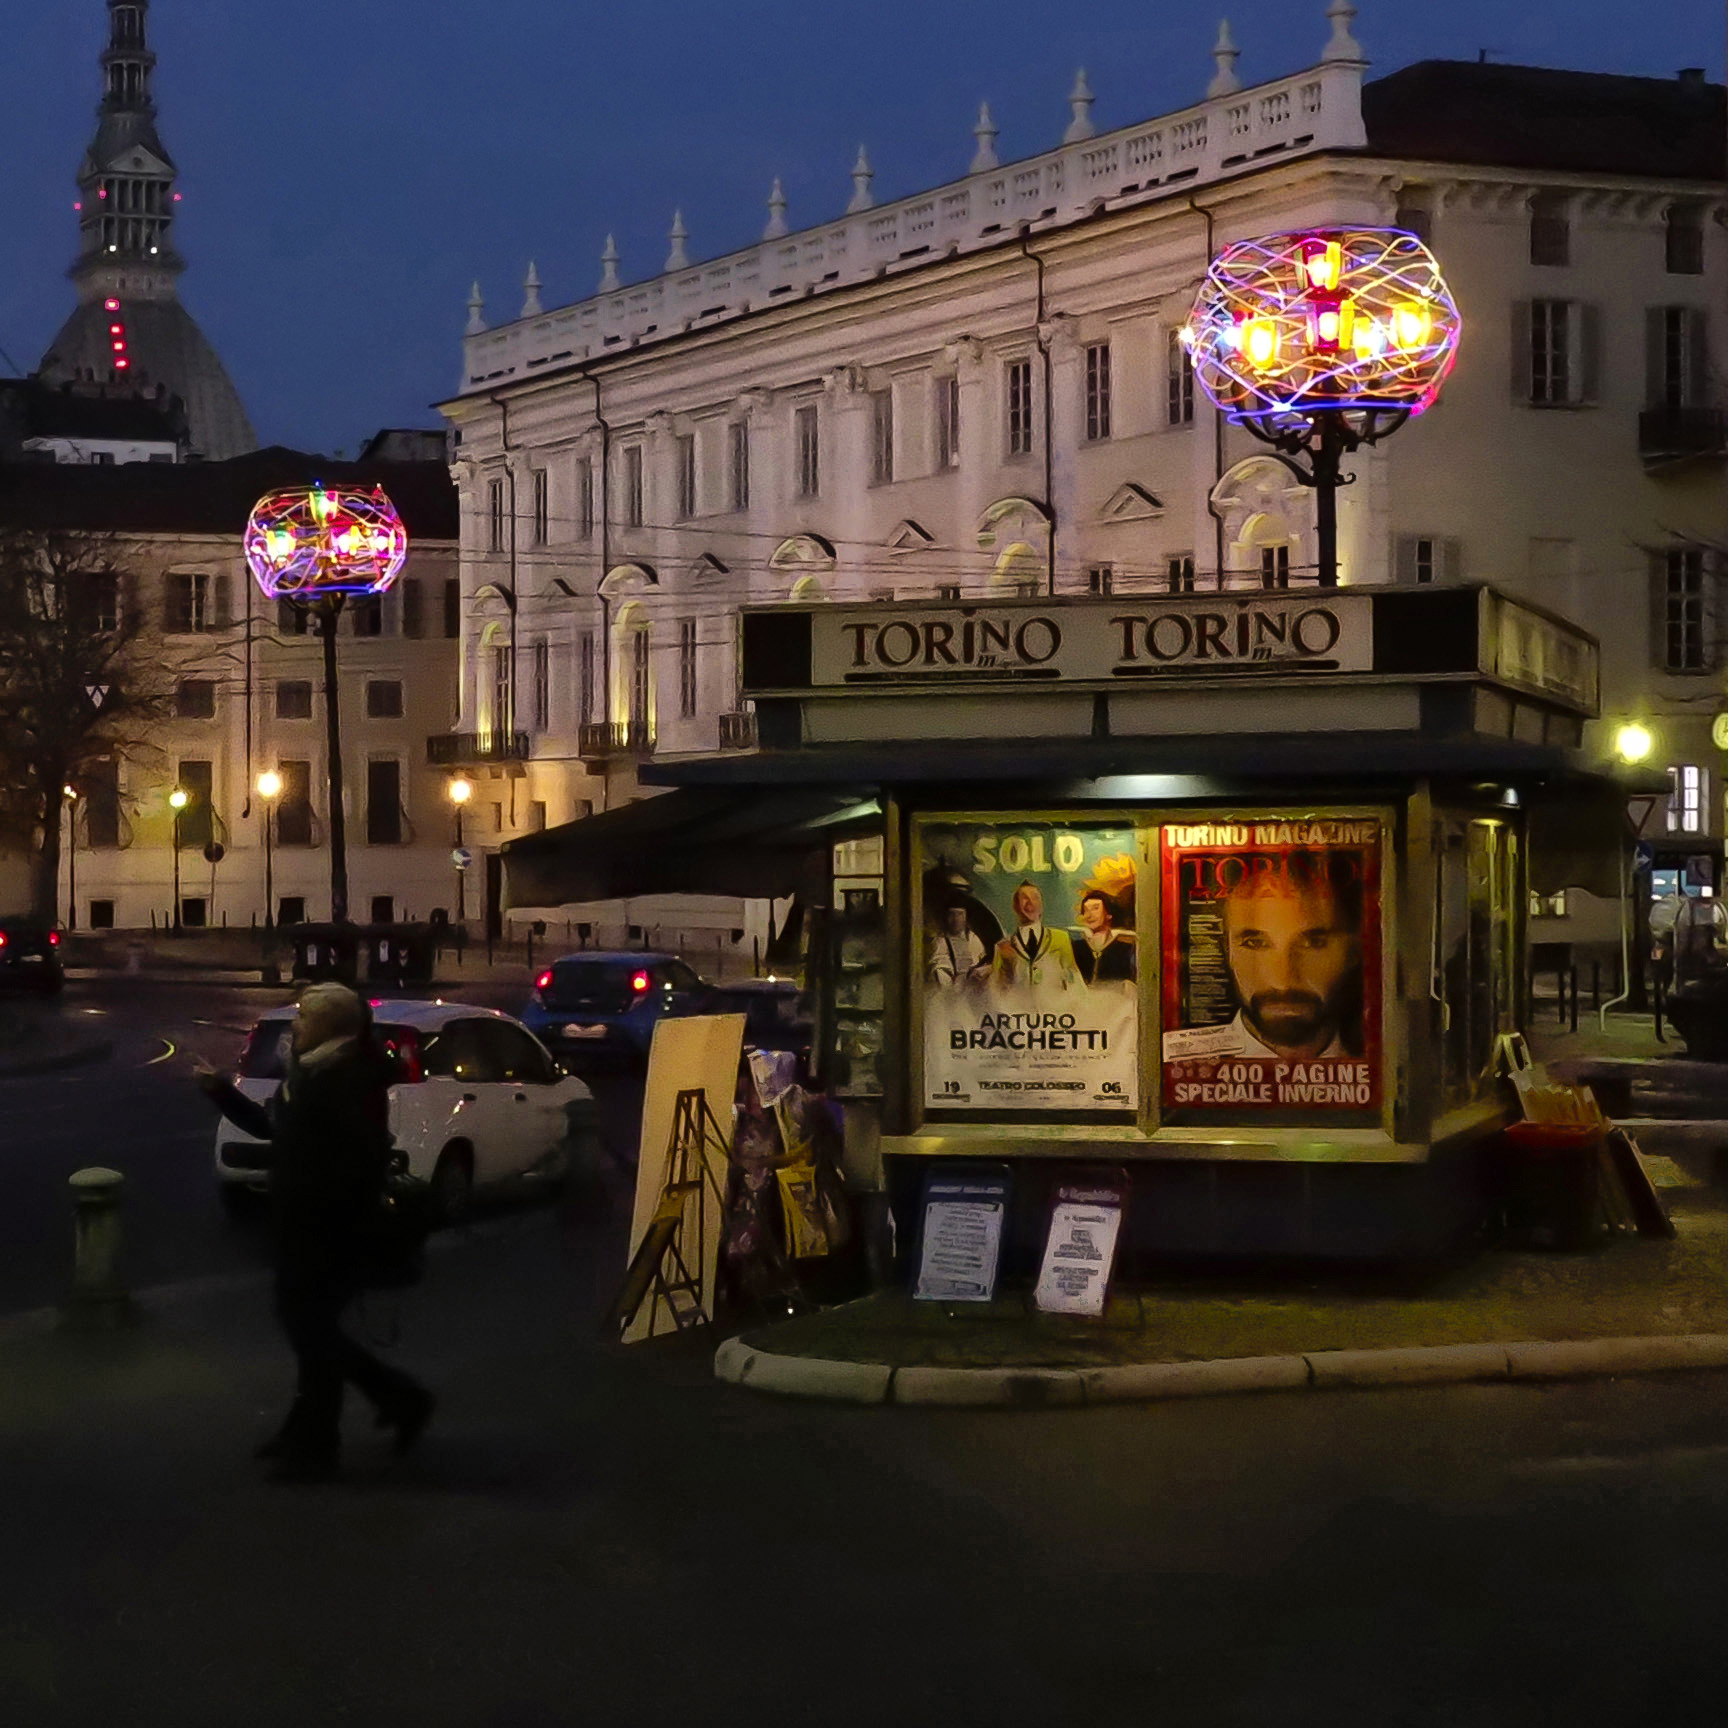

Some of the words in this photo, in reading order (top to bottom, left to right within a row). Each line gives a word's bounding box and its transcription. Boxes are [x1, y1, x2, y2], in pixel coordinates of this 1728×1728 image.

[841, 609, 1063, 667] TORINO
[1110, 599, 1342, 661] TORINO
[1164, 824, 1249, 848] TORINO
[972, 834, 1085, 873] SOLO
[980, 1013, 1076, 1030] ARTURO
[949, 1029, 1109, 1050] BRACHETTI
[1216, 1063, 1264, 1084] 400
[1274, 1063, 1371, 1084] PAGINE
[943, 1080, 962, 1094] 19
[978, 1080, 1022, 1091] TEATRO
[1101, 1080, 1122, 1094] 06
[1174, 1082, 1272, 1104] SPECIALE
[1277, 1083, 1371, 1104] INVERNO
